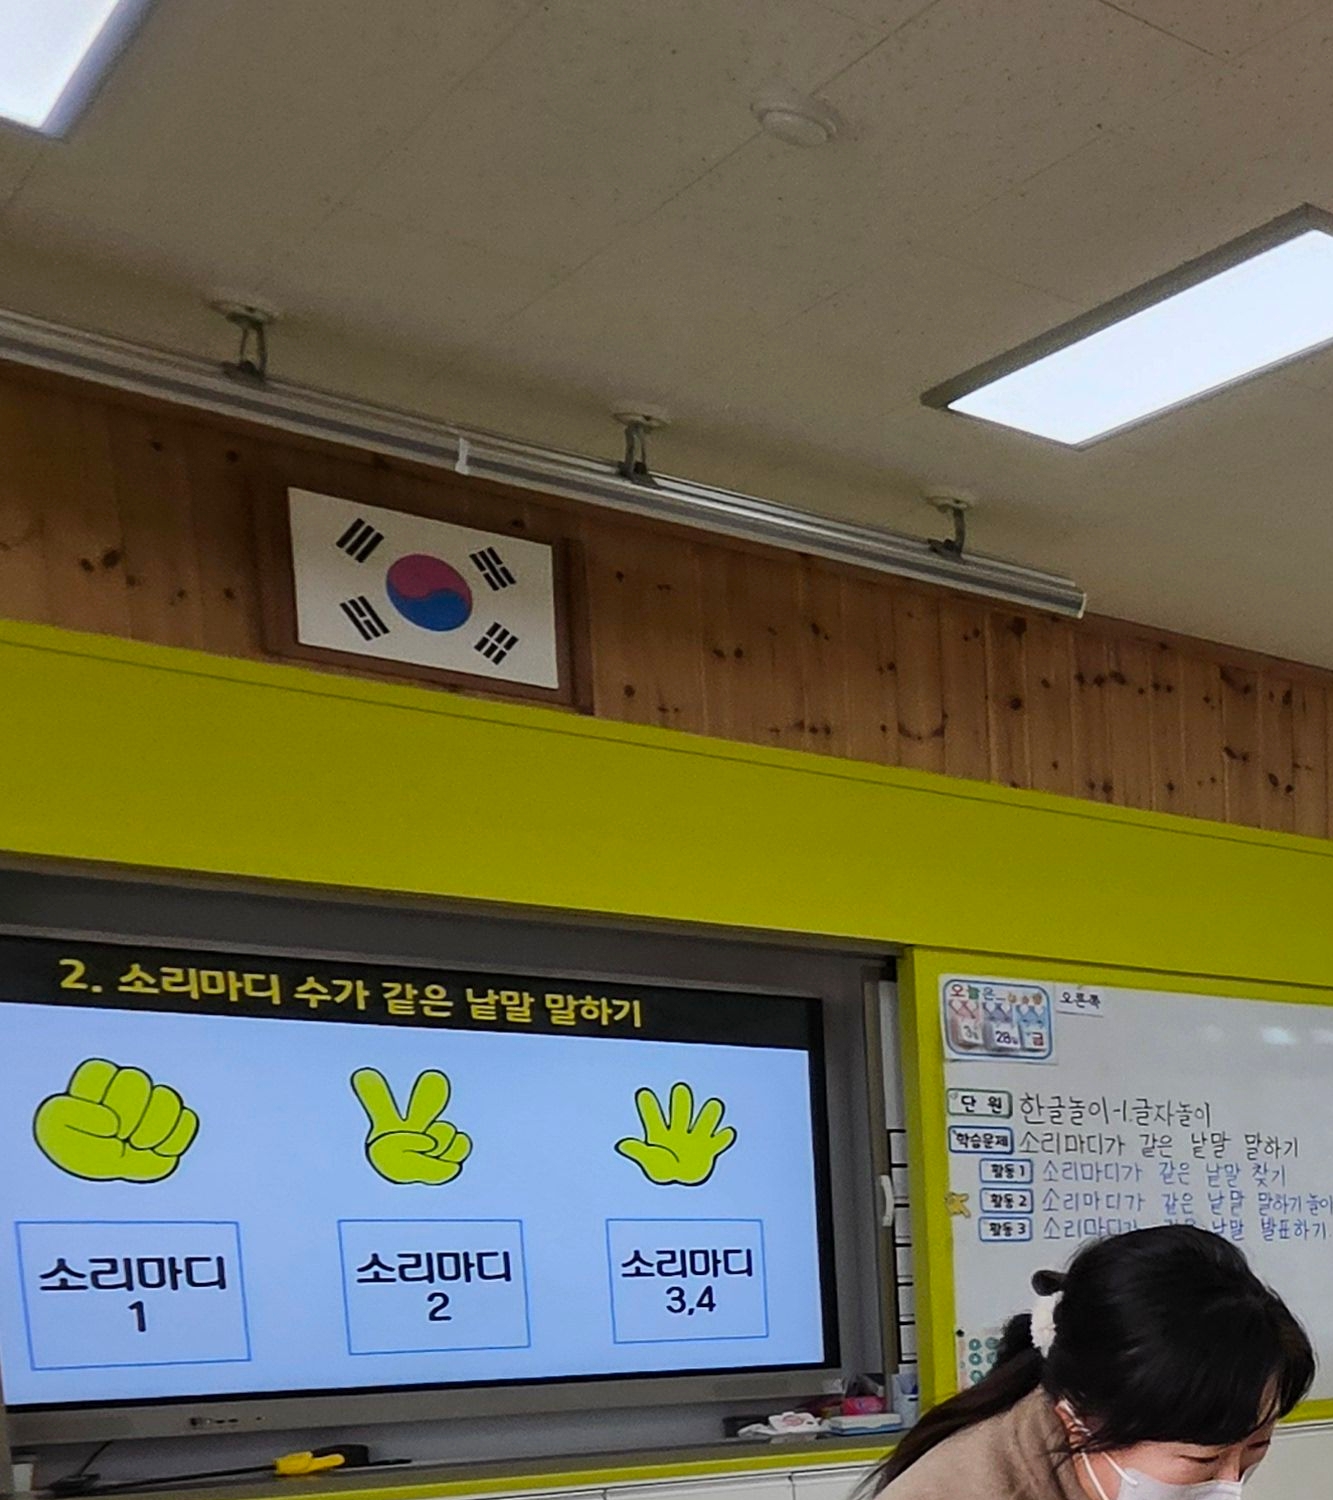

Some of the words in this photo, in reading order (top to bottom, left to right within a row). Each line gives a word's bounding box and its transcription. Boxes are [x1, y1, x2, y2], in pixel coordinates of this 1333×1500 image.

[58, 958, 103, 993] 2.
[118, 963, 281, 1005] 소리마디
[294, 976, 370, 1010] 수가
[381, 982, 453, 1018] 같은
[465, 988, 535, 1023] 낱말
[544, 993, 642, 1028] 말하기
[1019, 1131, 1126, 1156] 소리마디가
[1139, 1133, 1173, 1158] 같은
[1245, 1132, 1298, 1161] 말하기
[1043, 1160, 1143, 1183] 소리마디가
[1159, 1161, 1191, 1186] 같은
[1043, 1188, 1146, 1212] 소리마디가
[1162, 1192, 1194, 1216] 같은
[1258, 1192, 1302, 1217] 말하기
[39, 1256, 227, 1291] 소리마디
[356, 1251, 512, 1283] 소리마디
[621, 1249, 754, 1278] 소리마디
[128, 1300, 146, 1332] 1
[427, 1292, 452, 1321] 2
[665, 1286, 716, 1316] 3,4
